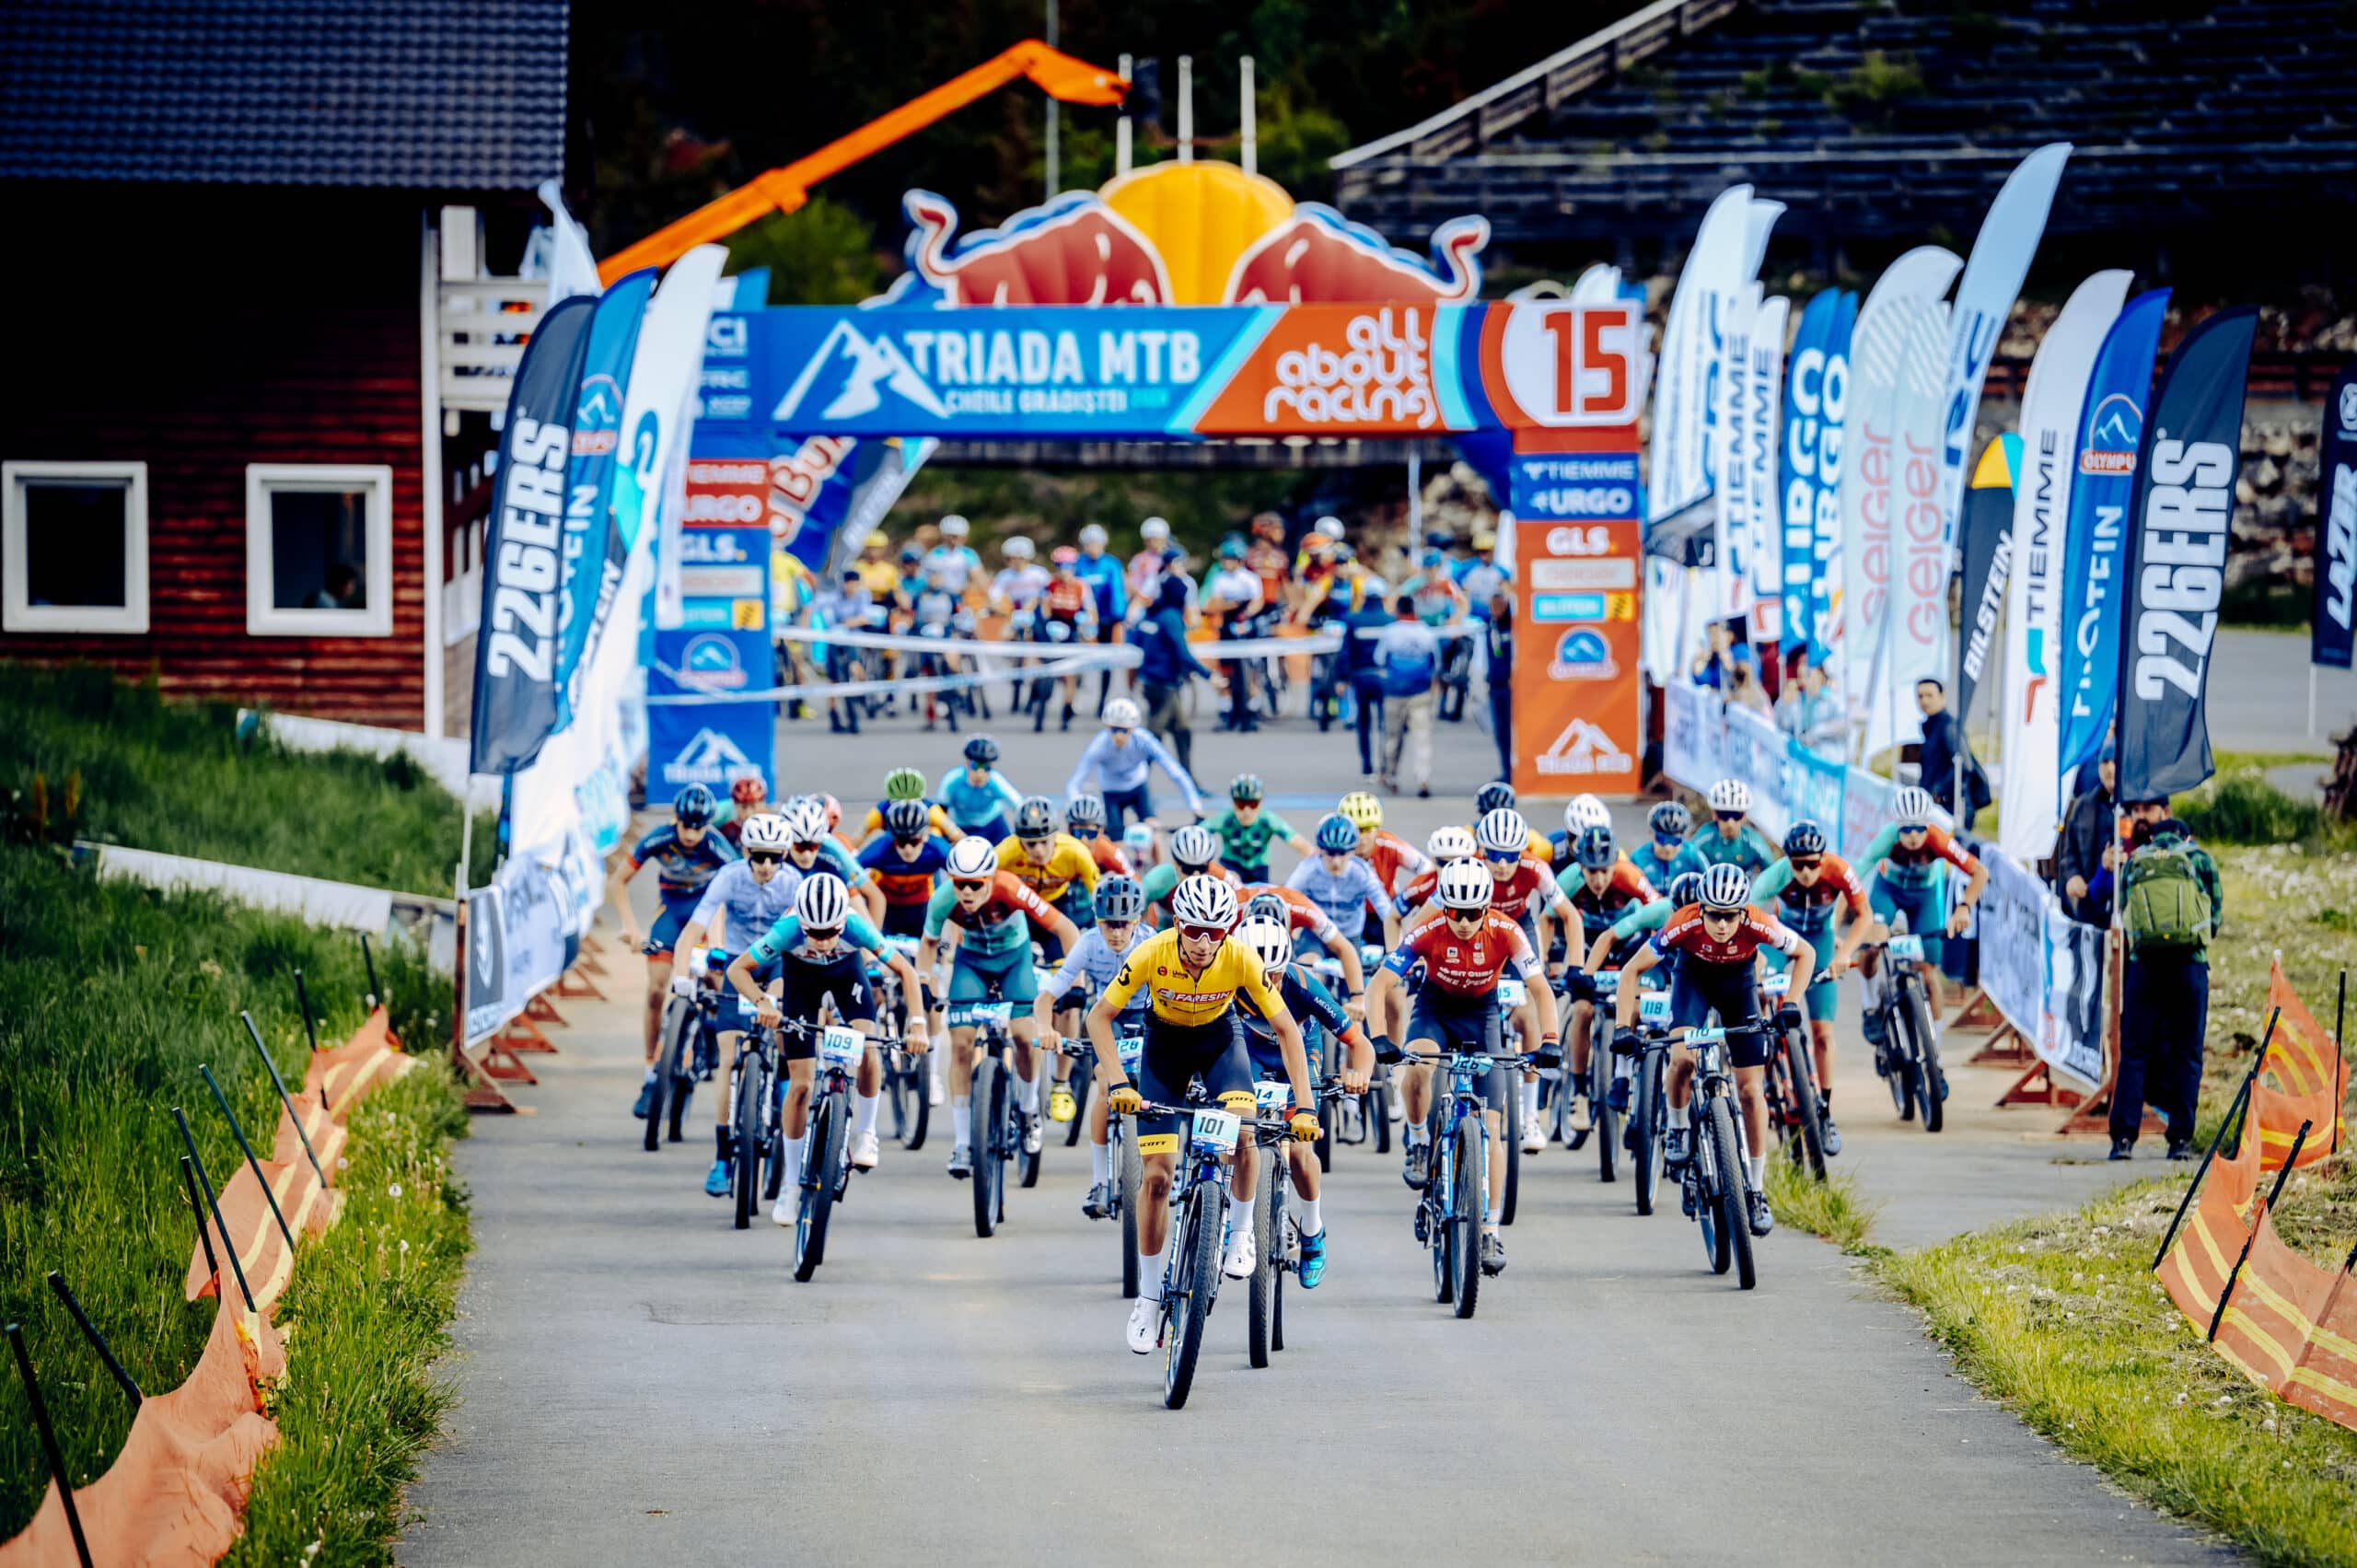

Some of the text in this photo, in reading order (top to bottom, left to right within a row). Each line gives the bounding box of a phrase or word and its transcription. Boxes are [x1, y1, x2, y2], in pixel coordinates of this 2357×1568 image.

[1346, 307, 1428, 353] all
[904, 330, 1201, 385] TRIADA MTB
[1275, 343, 1429, 388] about
[1543, 308, 1628, 413] 15
[1264, 384, 1436, 430] racing
[689, 464, 767, 486] IEMME
[1545, 461, 1636, 481] TIEMME
[1549, 487, 1632, 515] URGO
[2026, 427, 2058, 622] TIEMME
[2327, 462, 2357, 631] LAZER
[487, 416, 571, 682] 226ERS
[2135, 438, 2234, 701] 226ERS
[1962, 528, 2014, 684] BILSTEIN
[1016, 883, 1050, 917] HUN
[1175, 992, 1230, 1003] FARESIN
[827, 1033, 853, 1050] 109
[1198, 1116, 1225, 1136] 101
